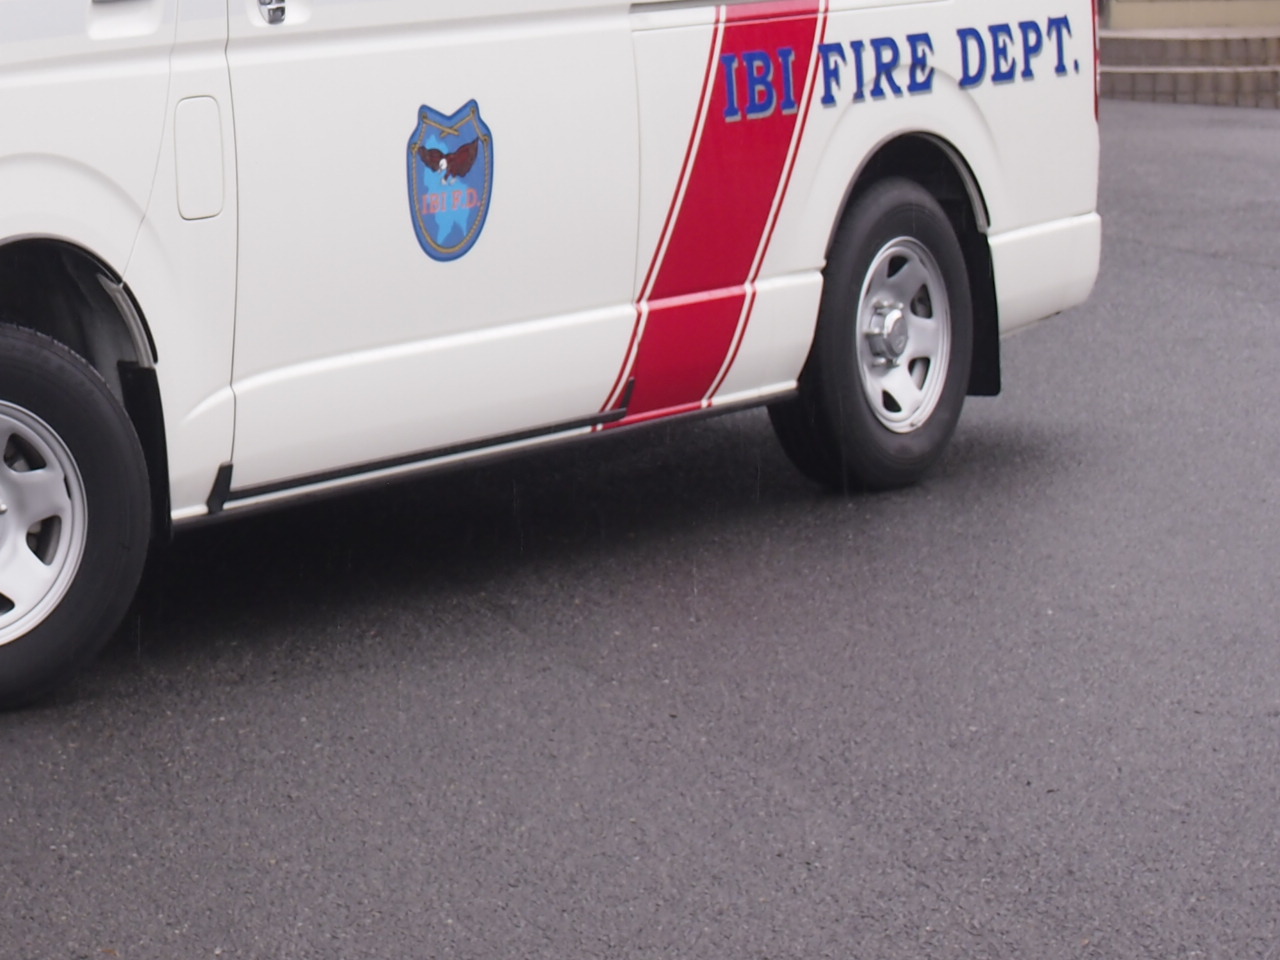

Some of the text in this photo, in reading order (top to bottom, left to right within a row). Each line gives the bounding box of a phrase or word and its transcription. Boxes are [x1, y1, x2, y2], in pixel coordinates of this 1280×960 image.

[721, 14, 1080, 122] IBI FIRE DEPT.
[422, 187, 482, 215] IBI F.D.
